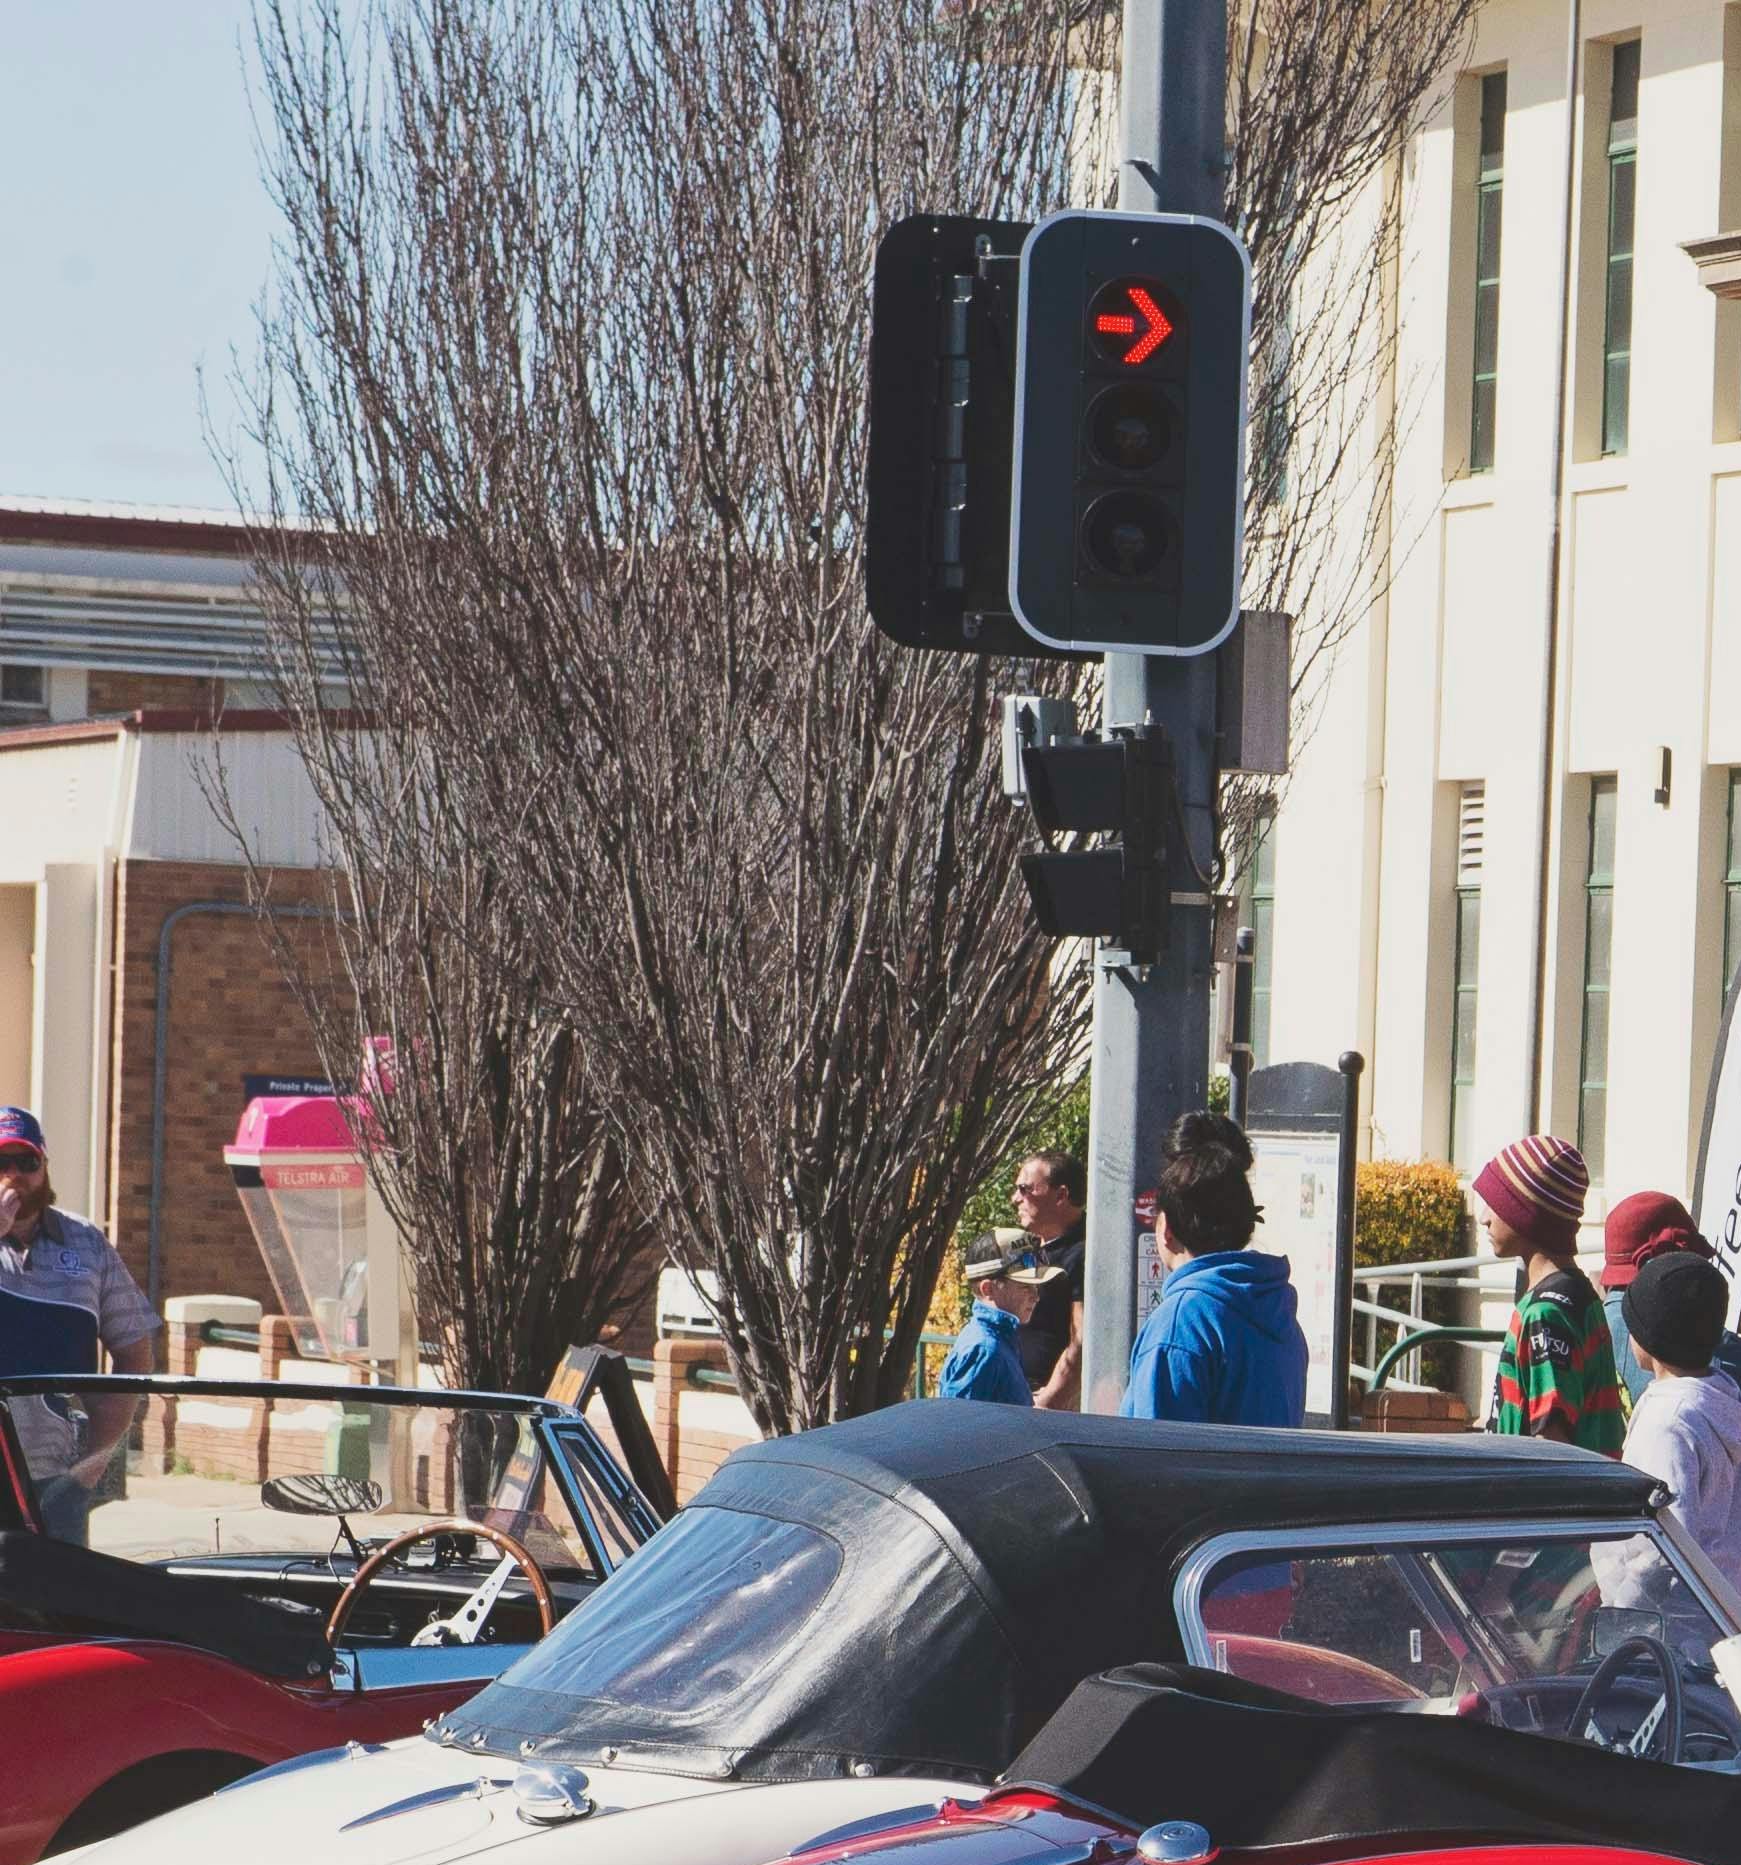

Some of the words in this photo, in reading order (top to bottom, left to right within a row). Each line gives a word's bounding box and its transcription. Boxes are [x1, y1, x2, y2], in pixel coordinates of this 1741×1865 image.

[269, 1081, 300, 1092] Private
[277, 1171, 326, 1185] TELSTRA
[329, 1171, 350, 1184] AIR
